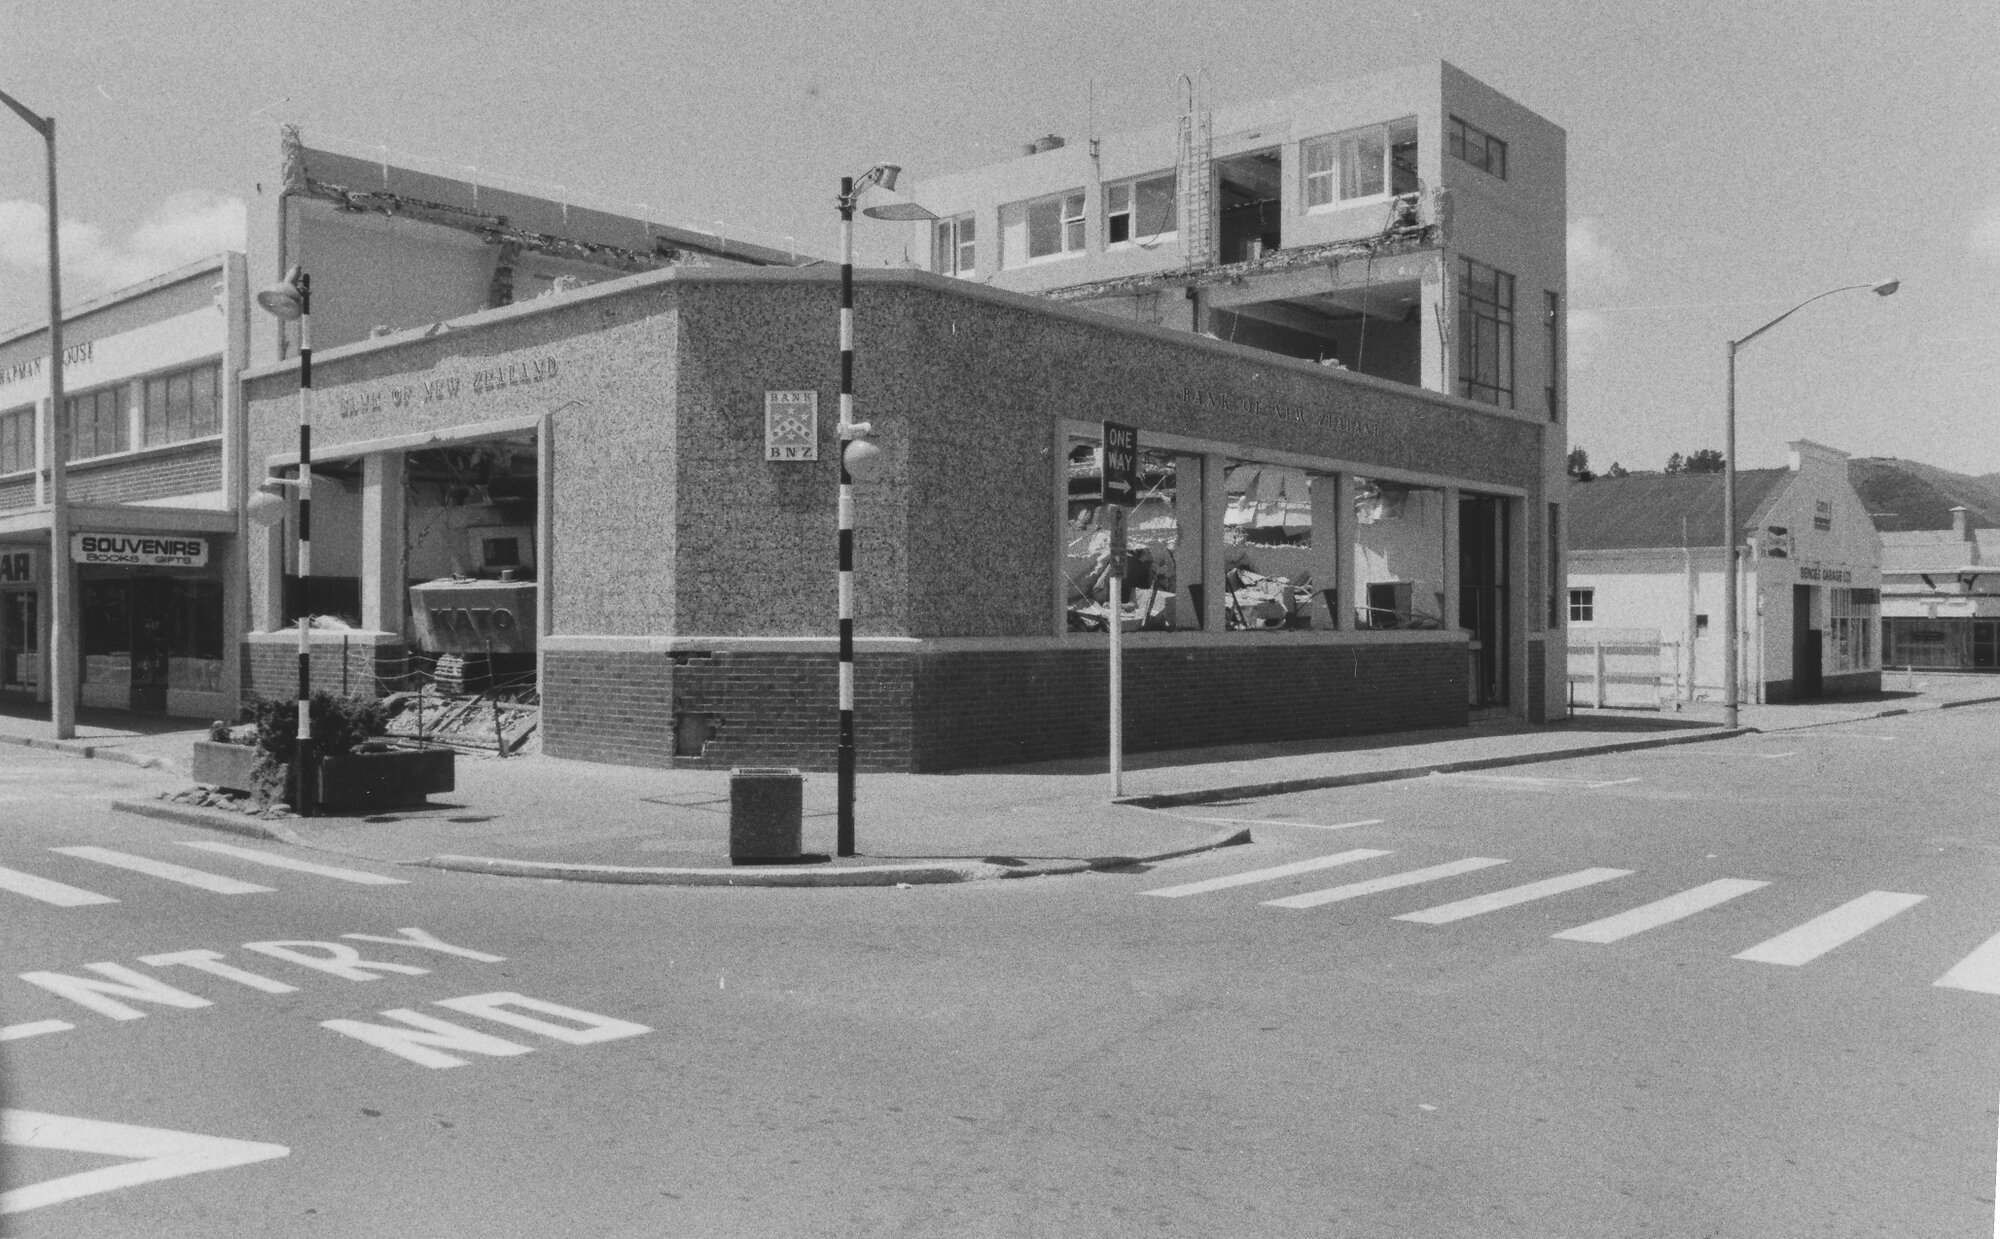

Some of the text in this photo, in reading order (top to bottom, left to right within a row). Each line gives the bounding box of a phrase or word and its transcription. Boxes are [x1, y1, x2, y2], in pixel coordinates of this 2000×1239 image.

[770, 393, 811, 402] BANK
[1181, 386, 1230, 411] BANK
[1109, 428, 1133, 449] ONE
[1108, 451, 1133, 472] WAY
[81, 536, 201, 557] SOUVENIRS
[86, 553, 192, 565] BOOKS GIFTS
[430, 607, 521, 643] KATO
[319, 991, 655, 1069] NO
